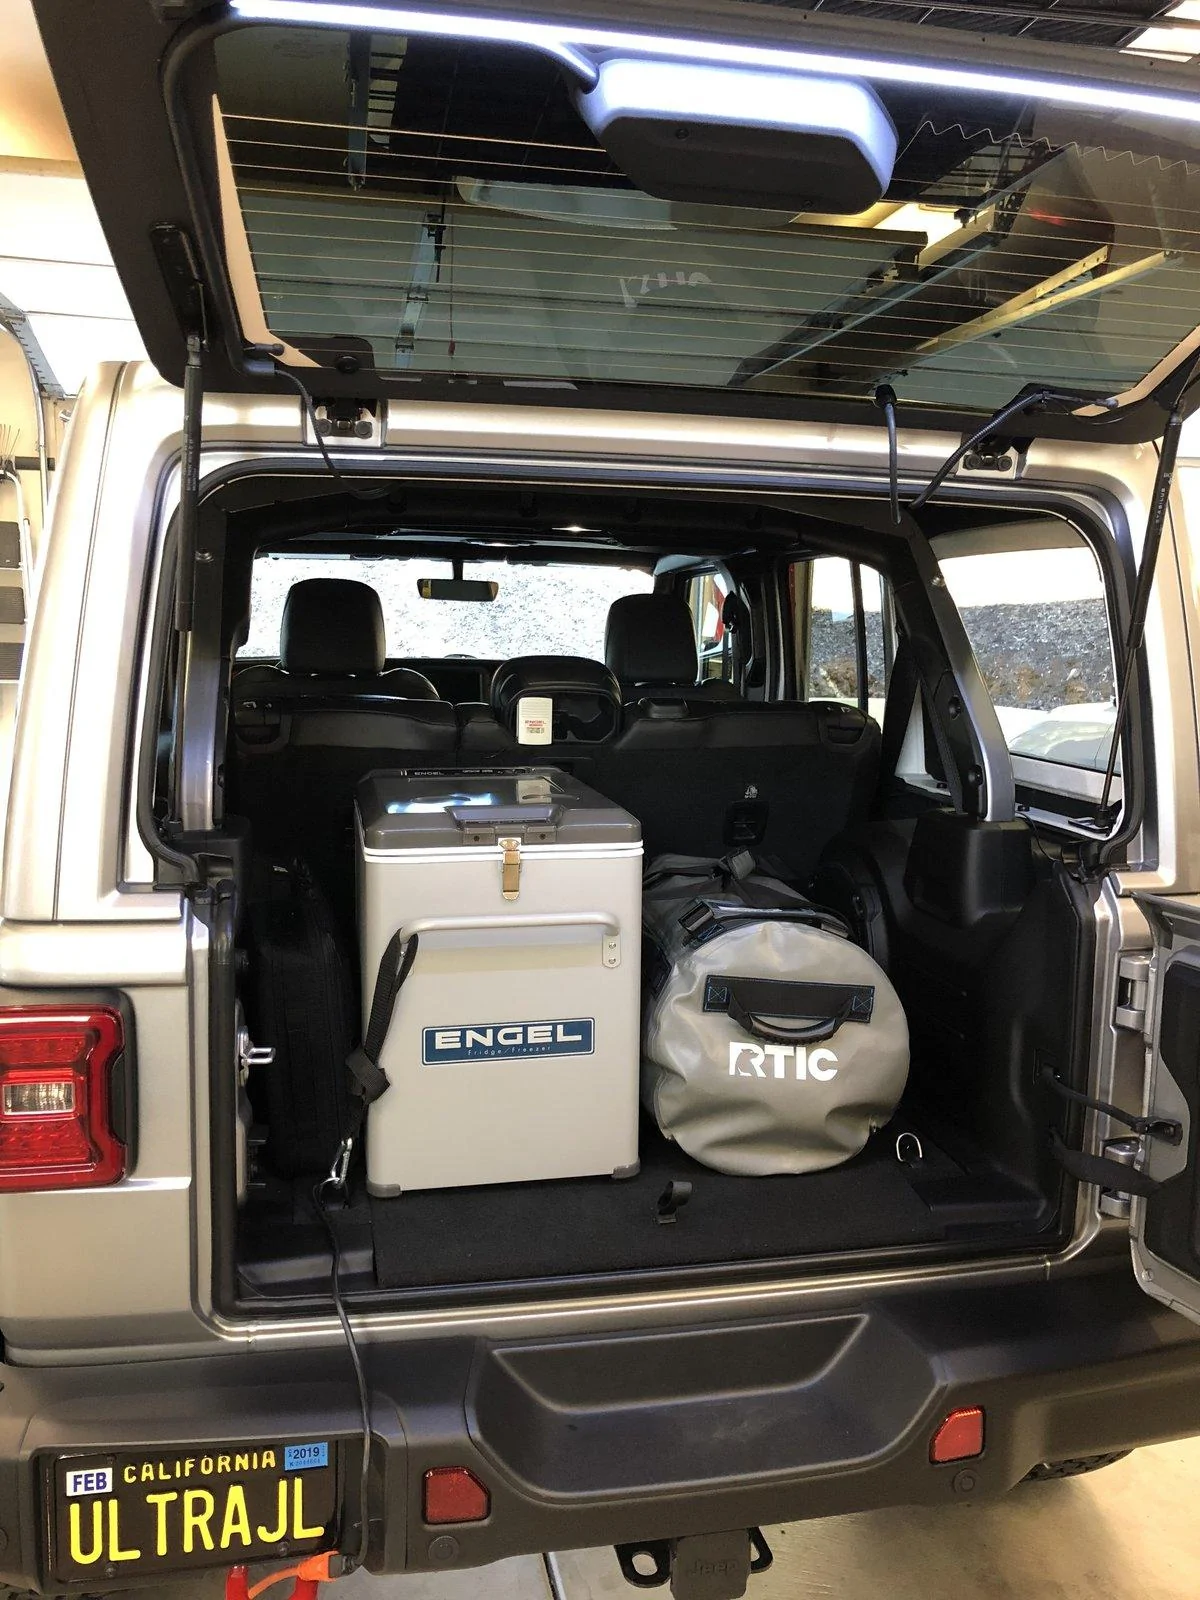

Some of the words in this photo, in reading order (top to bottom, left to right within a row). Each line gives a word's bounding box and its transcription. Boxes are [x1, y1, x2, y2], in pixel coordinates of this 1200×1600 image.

[434, 1024, 583, 1050] ENGEL
[728, 1041, 839, 1082] RTIC
[123, 1450, 277, 1484] CALIFORNIA
[293, 1446, 320, 1460] 2019
[72, 1470, 108, 1493] FEB
[69, 1476, 325, 1565] ULTRAJL
